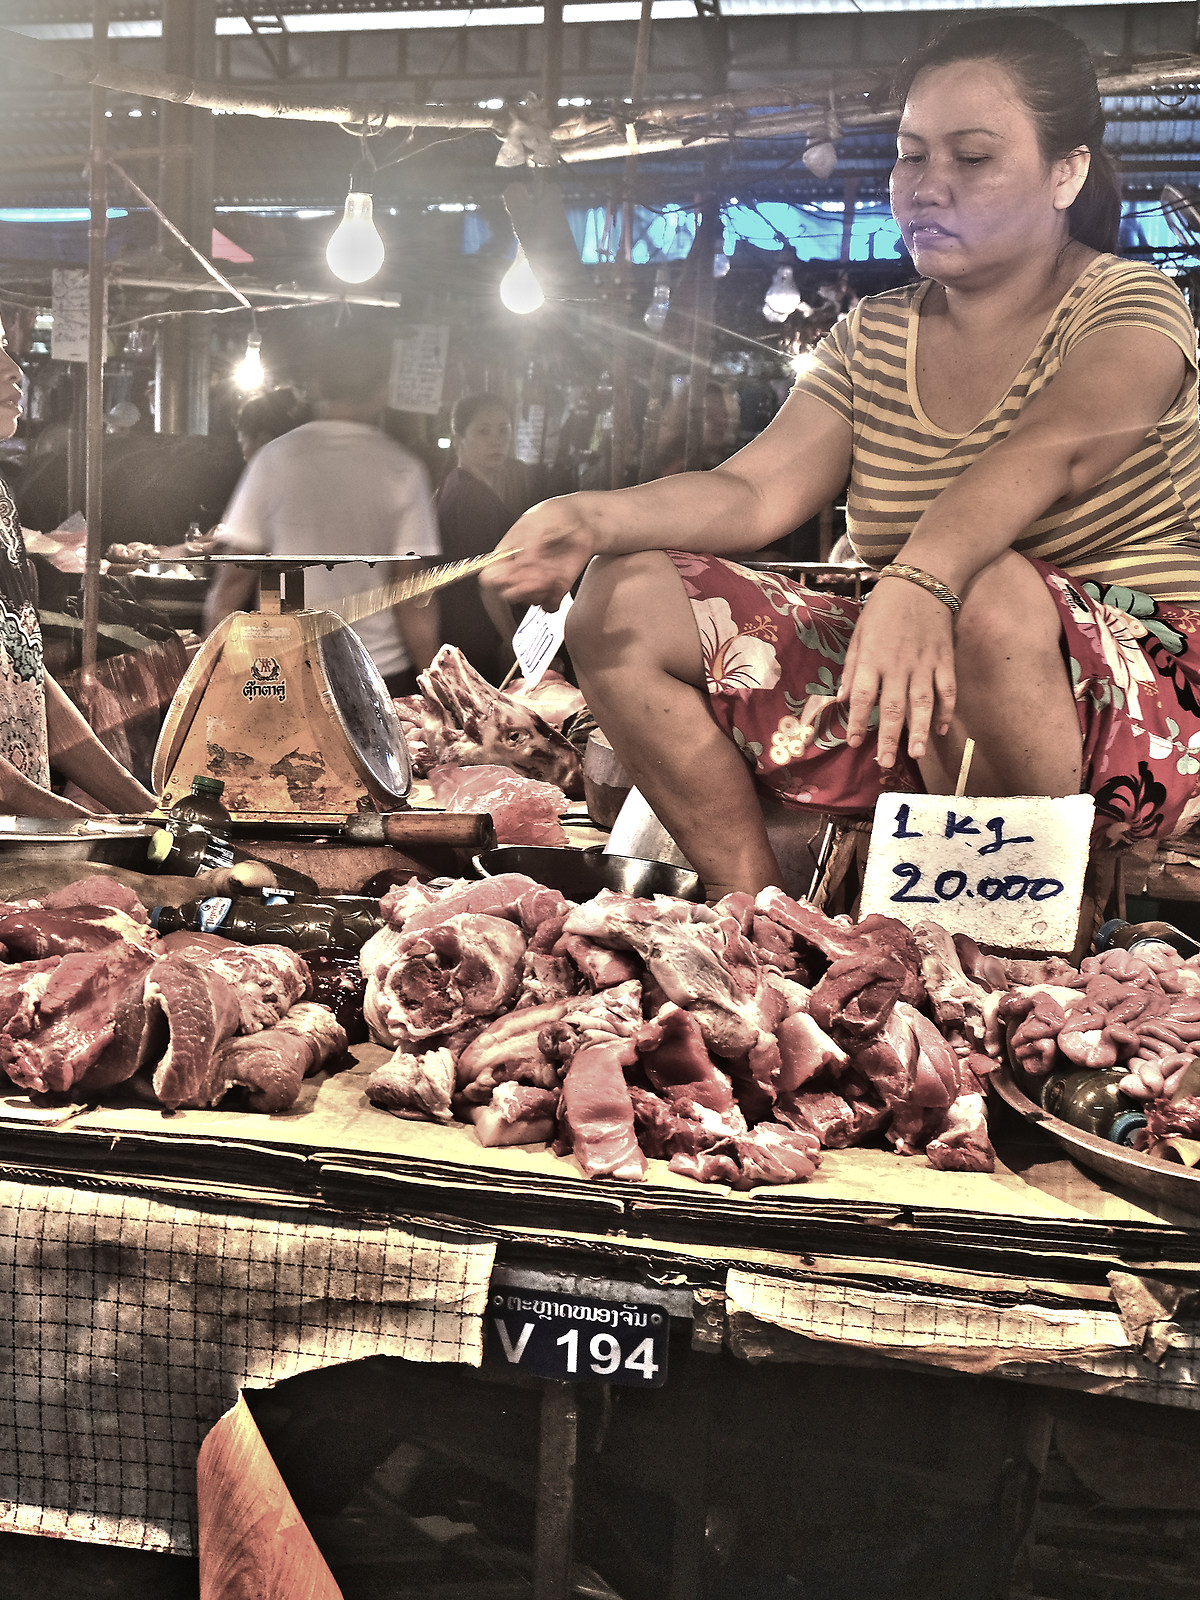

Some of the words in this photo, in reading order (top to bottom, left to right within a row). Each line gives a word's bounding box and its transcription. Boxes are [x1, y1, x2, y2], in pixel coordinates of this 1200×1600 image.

[243, 681, 285, 701] ตุ๊กตาคู่
[892, 803, 924, 838] 1
[890, 862, 1064, 903] 20.000
[494, 1318, 536, 1364] V
[556, 1328, 660, 1380] 194
